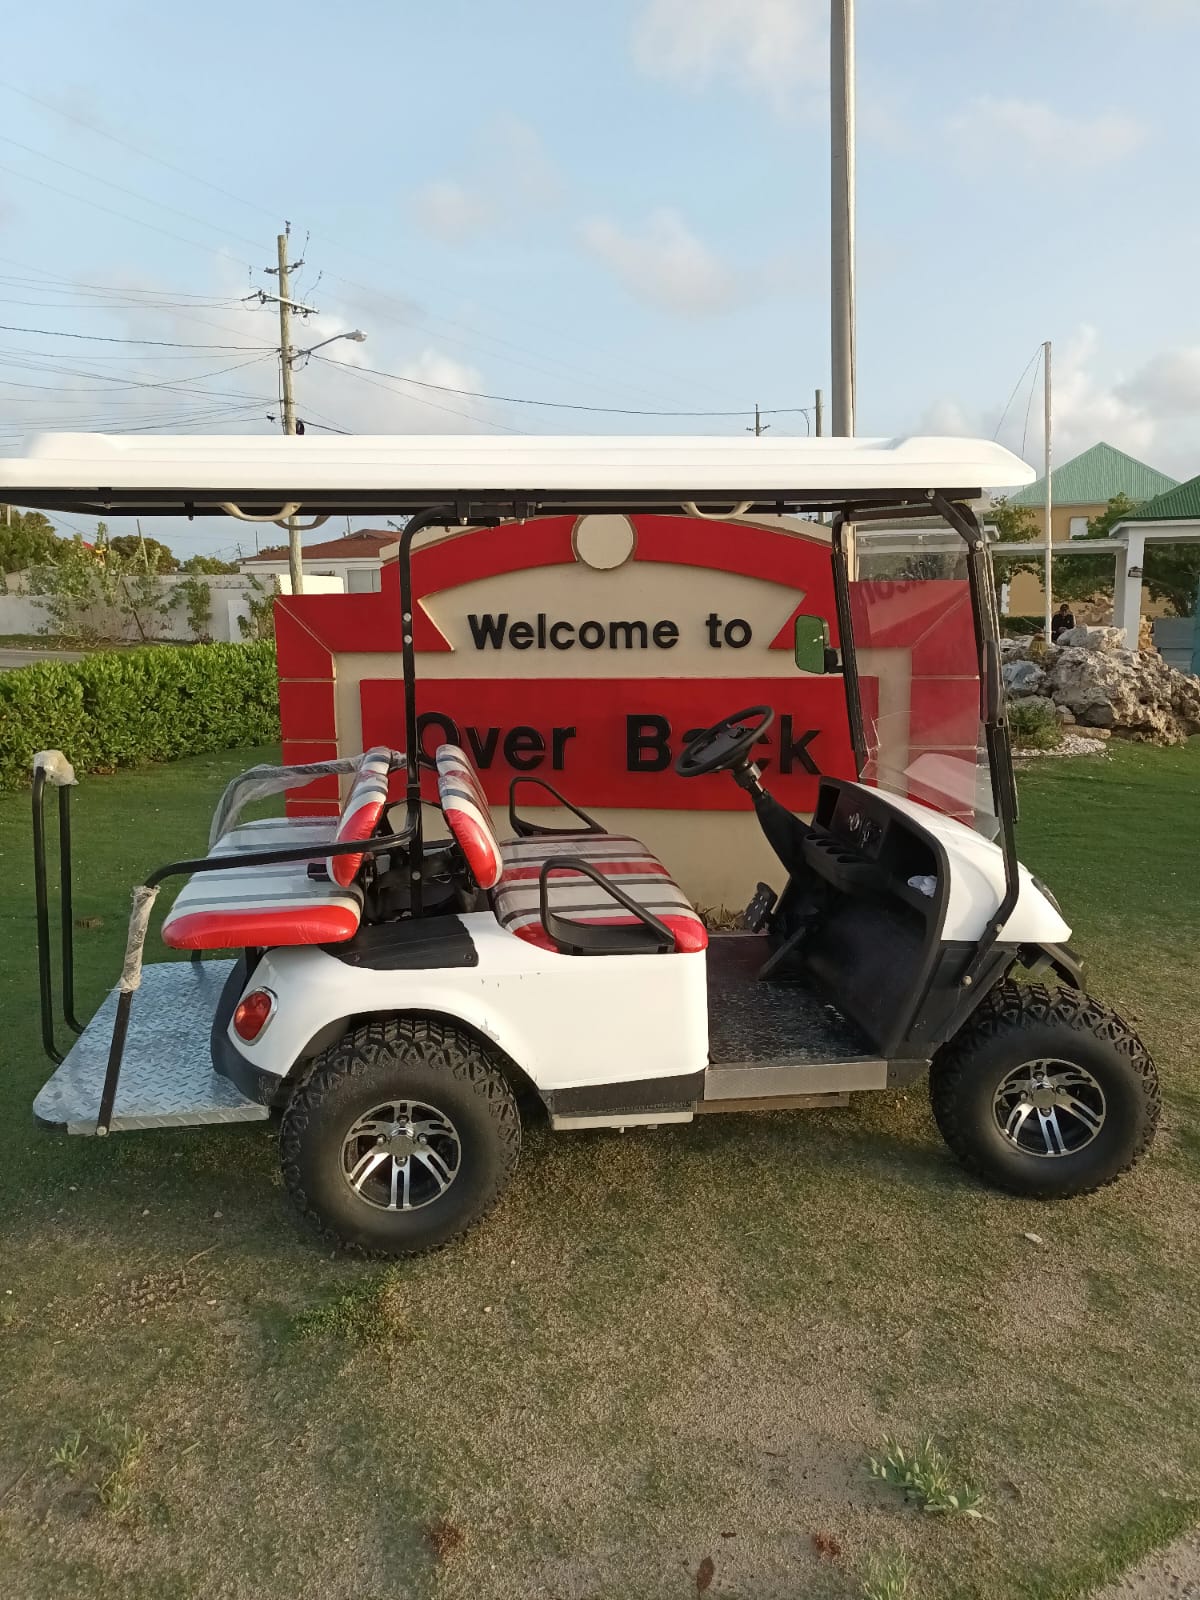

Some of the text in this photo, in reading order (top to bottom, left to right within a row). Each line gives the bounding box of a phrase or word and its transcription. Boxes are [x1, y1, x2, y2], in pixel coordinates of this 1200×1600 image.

[467, 613, 753, 650] Welcome to
[414, 711, 822, 776] Over Bk
